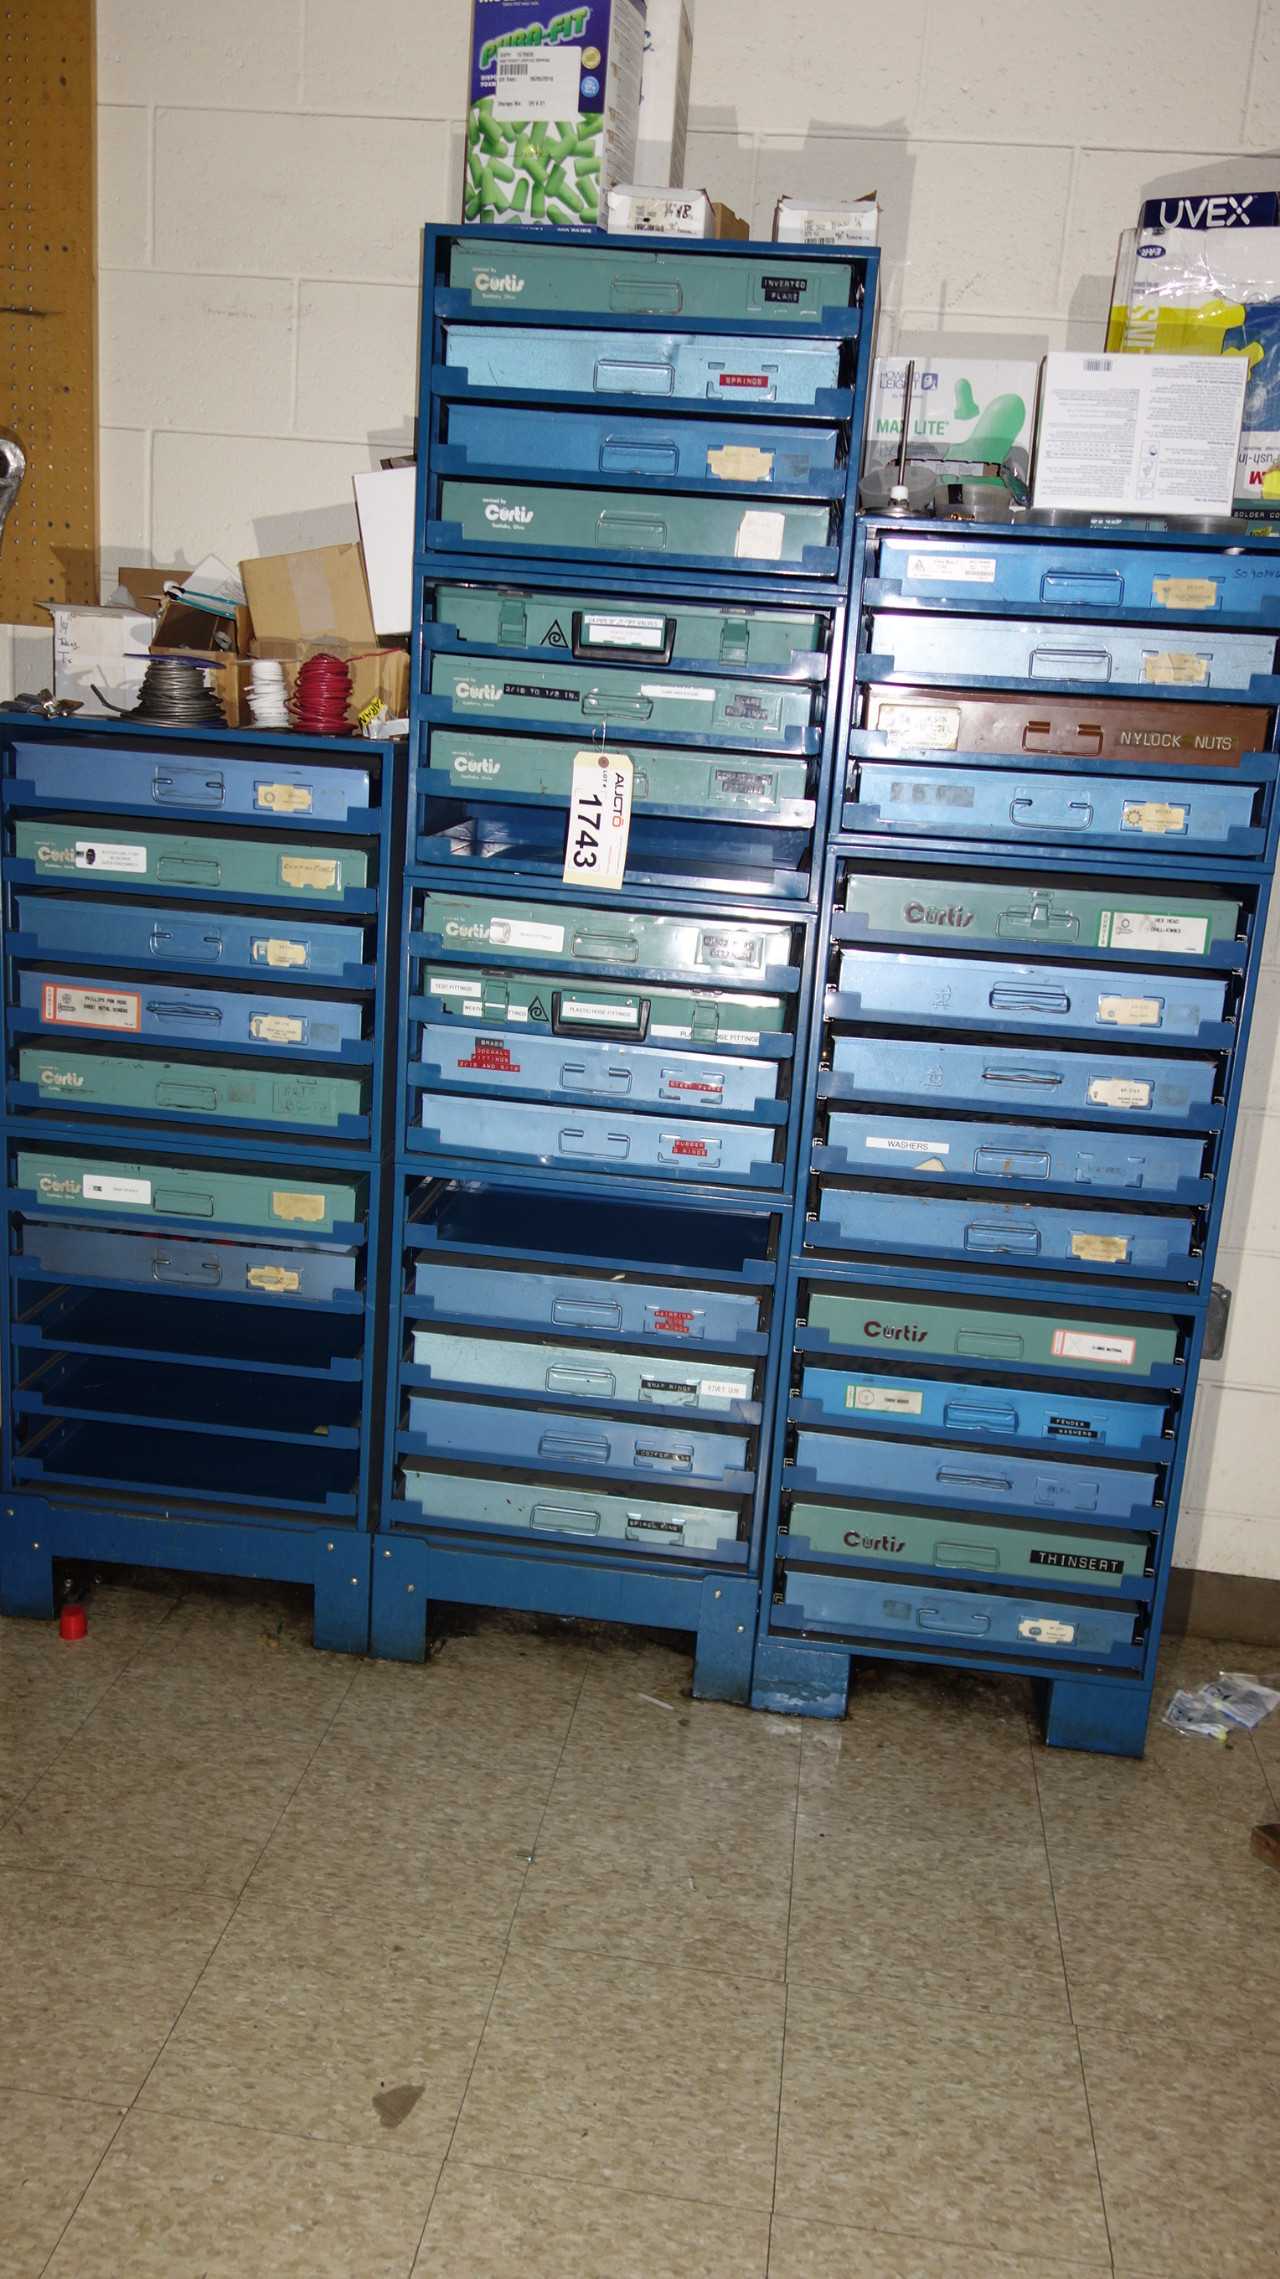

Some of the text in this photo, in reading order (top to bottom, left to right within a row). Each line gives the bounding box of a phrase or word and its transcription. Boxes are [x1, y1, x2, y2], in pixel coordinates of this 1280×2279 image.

[1159, 195, 1253, 229] UVEX
[475, 272, 525, 292] Curtis
[764, 279, 806, 289] INVERTED
[725, 377, 762, 386] SPRINGS
[914, 420, 945, 436] LITE
[484, 503, 534, 523] Curtis
[455, 682, 503, 700] Curtis
[531, 688, 540, 696] TO
[1120, 731, 1233, 750] NYLOCK NUTS
[454, 756, 500, 774] Curtis
[573, 794, 603, 868] 1743
[38, 846, 76, 863] Curti
[904, 900, 975, 928] Curtis
[41, 1070, 84, 1086] Curtis
[887, 1140, 929, 1150] WASHERS
[40, 1177, 80, 1194] Curtis
[864, 1320, 928, 1342] Curtis
[1056, 1418, 1085, 1426] FENDER
[843, 1531, 906, 1552] Curtis
[1039, 1551, 1119, 1572] THINSERT
